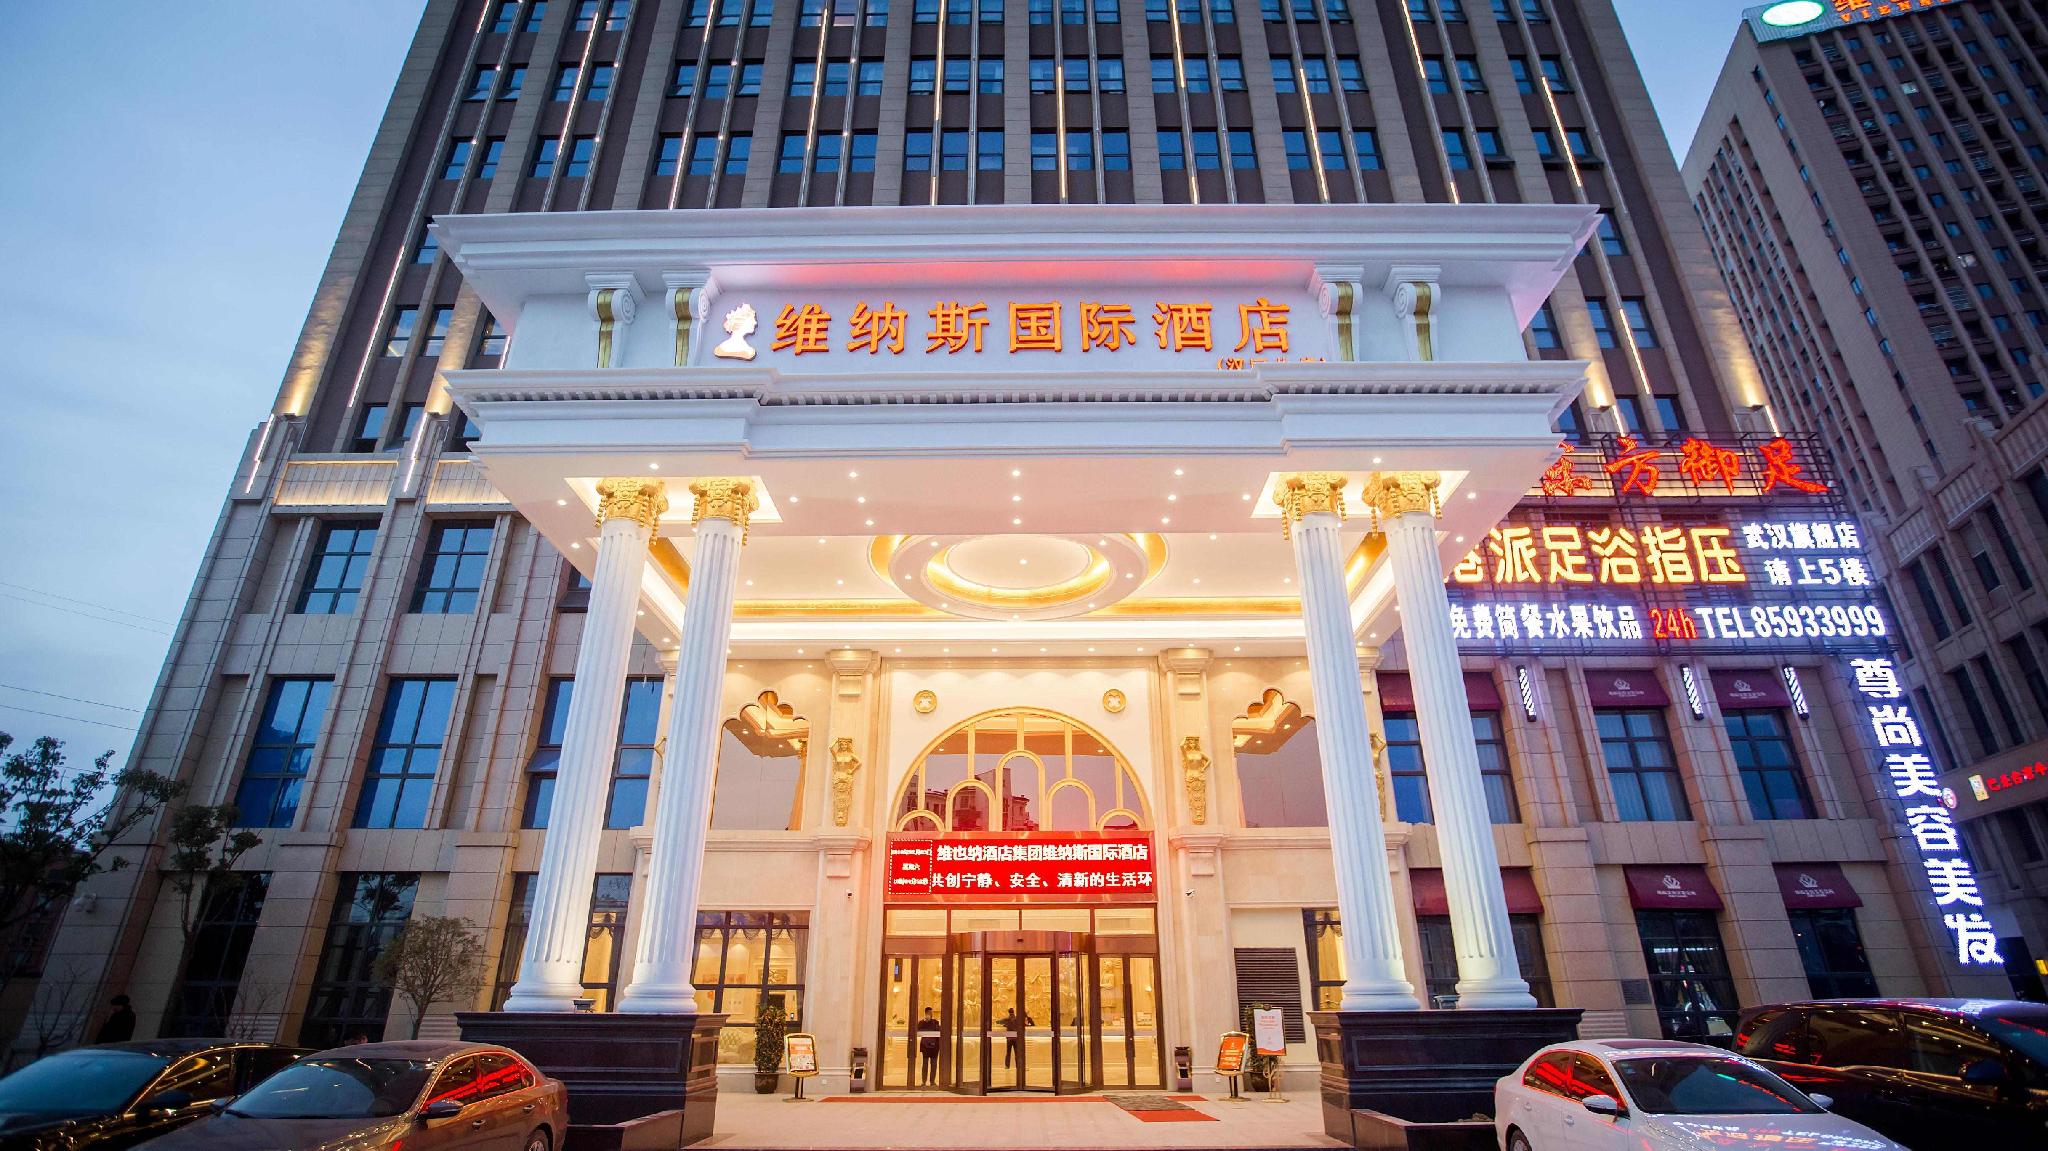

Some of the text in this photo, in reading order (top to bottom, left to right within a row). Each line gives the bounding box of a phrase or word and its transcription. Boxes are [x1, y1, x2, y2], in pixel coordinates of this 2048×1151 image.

[771, 299, 1291, 354] 维纳斯国际酒店
[1742, 521, 1860, 550] 武汉旗舰店
[1763, 557, 1871, 586] 请上5楼
[1450, 602, 1643, 640] 免费简餐水果饮品
[1649, 607, 1698, 640] 24h
[1850, 658, 2004, 965] 尊尚美容美发
[936, 844, 1148, 862] 维也纳酒店集团维纳斯国际酒店
